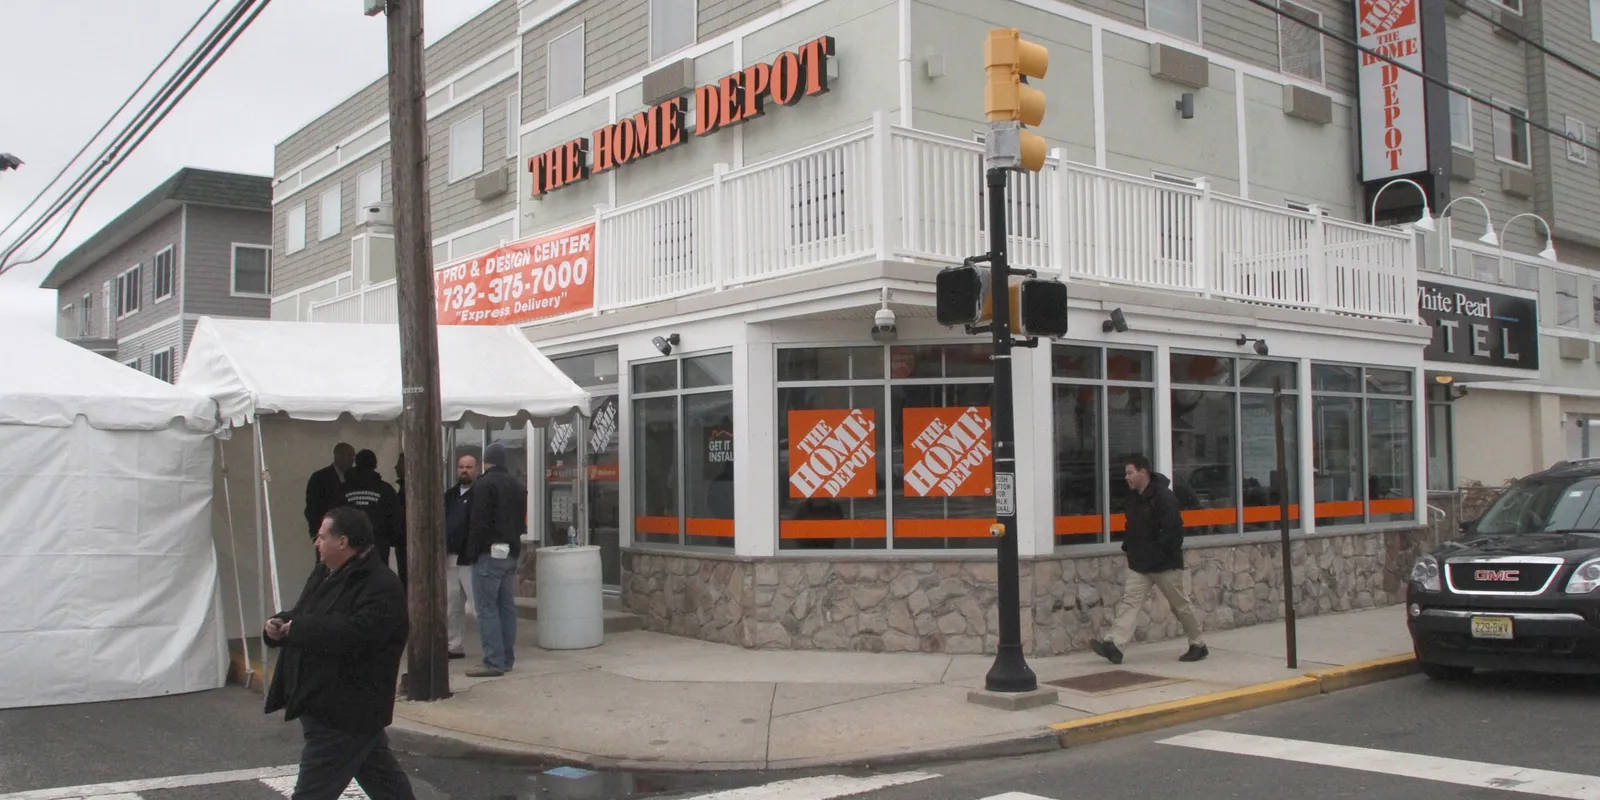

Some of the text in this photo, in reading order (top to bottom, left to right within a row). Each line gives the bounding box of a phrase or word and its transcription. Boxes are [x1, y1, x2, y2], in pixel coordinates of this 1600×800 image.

[1377, 31, 1399, 45] THE
[528, 36, 833, 196] THE HOME DEPOT
[1380, 64, 1403, 171] DEPOT
[443, 233, 591, 284] PRO & DESIGN CENTER
[1456, 292, 1491, 319] Pearl
[1439, 319, 1520, 361] TEL
[709, 440, 731, 451] GET IT
[789, 408, 876, 498] HOME
[797, 419, 833, 455] THE
[904, 406, 992, 497] HOME
[911, 416, 948, 453] THE
[709, 451, 734, 462] INSTAL
[823, 440, 876, 497] DEPOT
[938, 438, 992, 496] DEPOT
[1475, 570, 1519, 581] GMC
